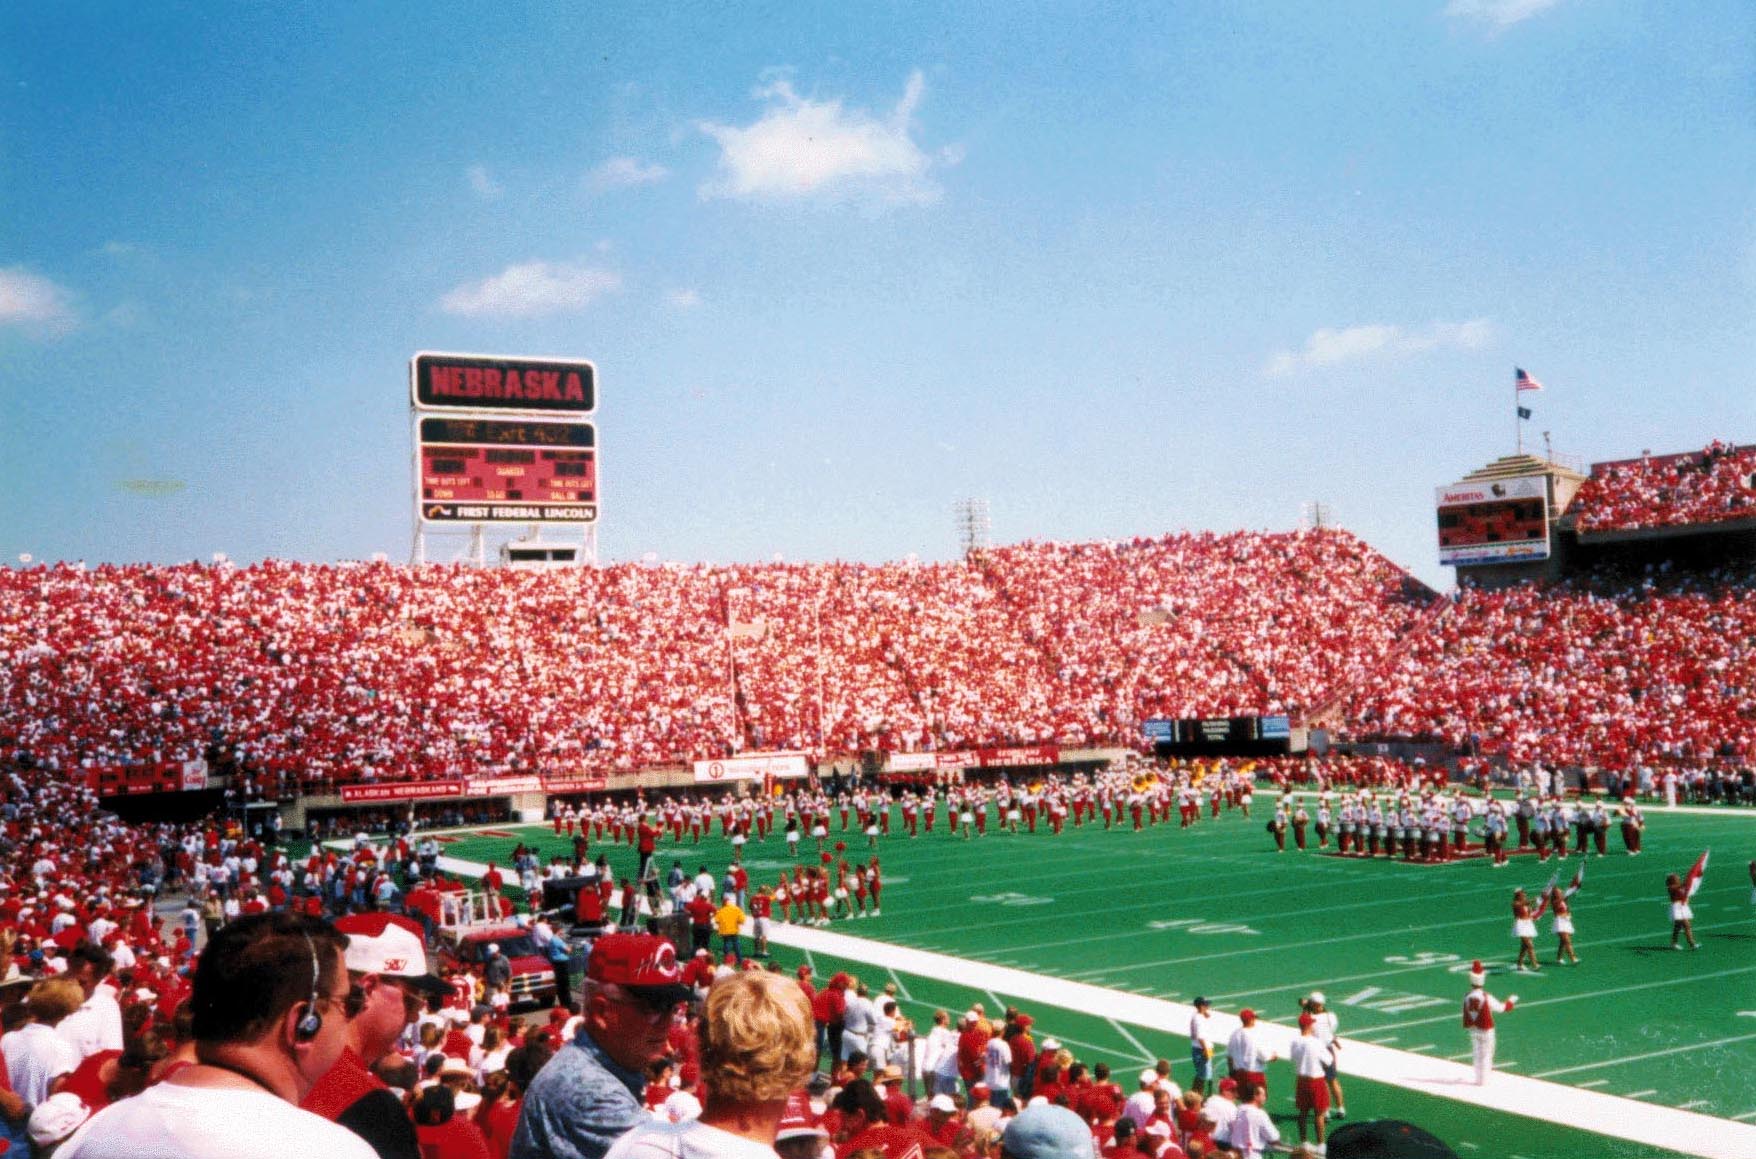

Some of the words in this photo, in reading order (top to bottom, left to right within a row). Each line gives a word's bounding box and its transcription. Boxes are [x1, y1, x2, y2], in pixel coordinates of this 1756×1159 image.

[430, 366, 584, 400] NEBRASKA
[457, 506, 489, 517] FIRST
[492, 507, 541, 518] FEDERAL
[544, 507, 594, 519] LINCOLN
